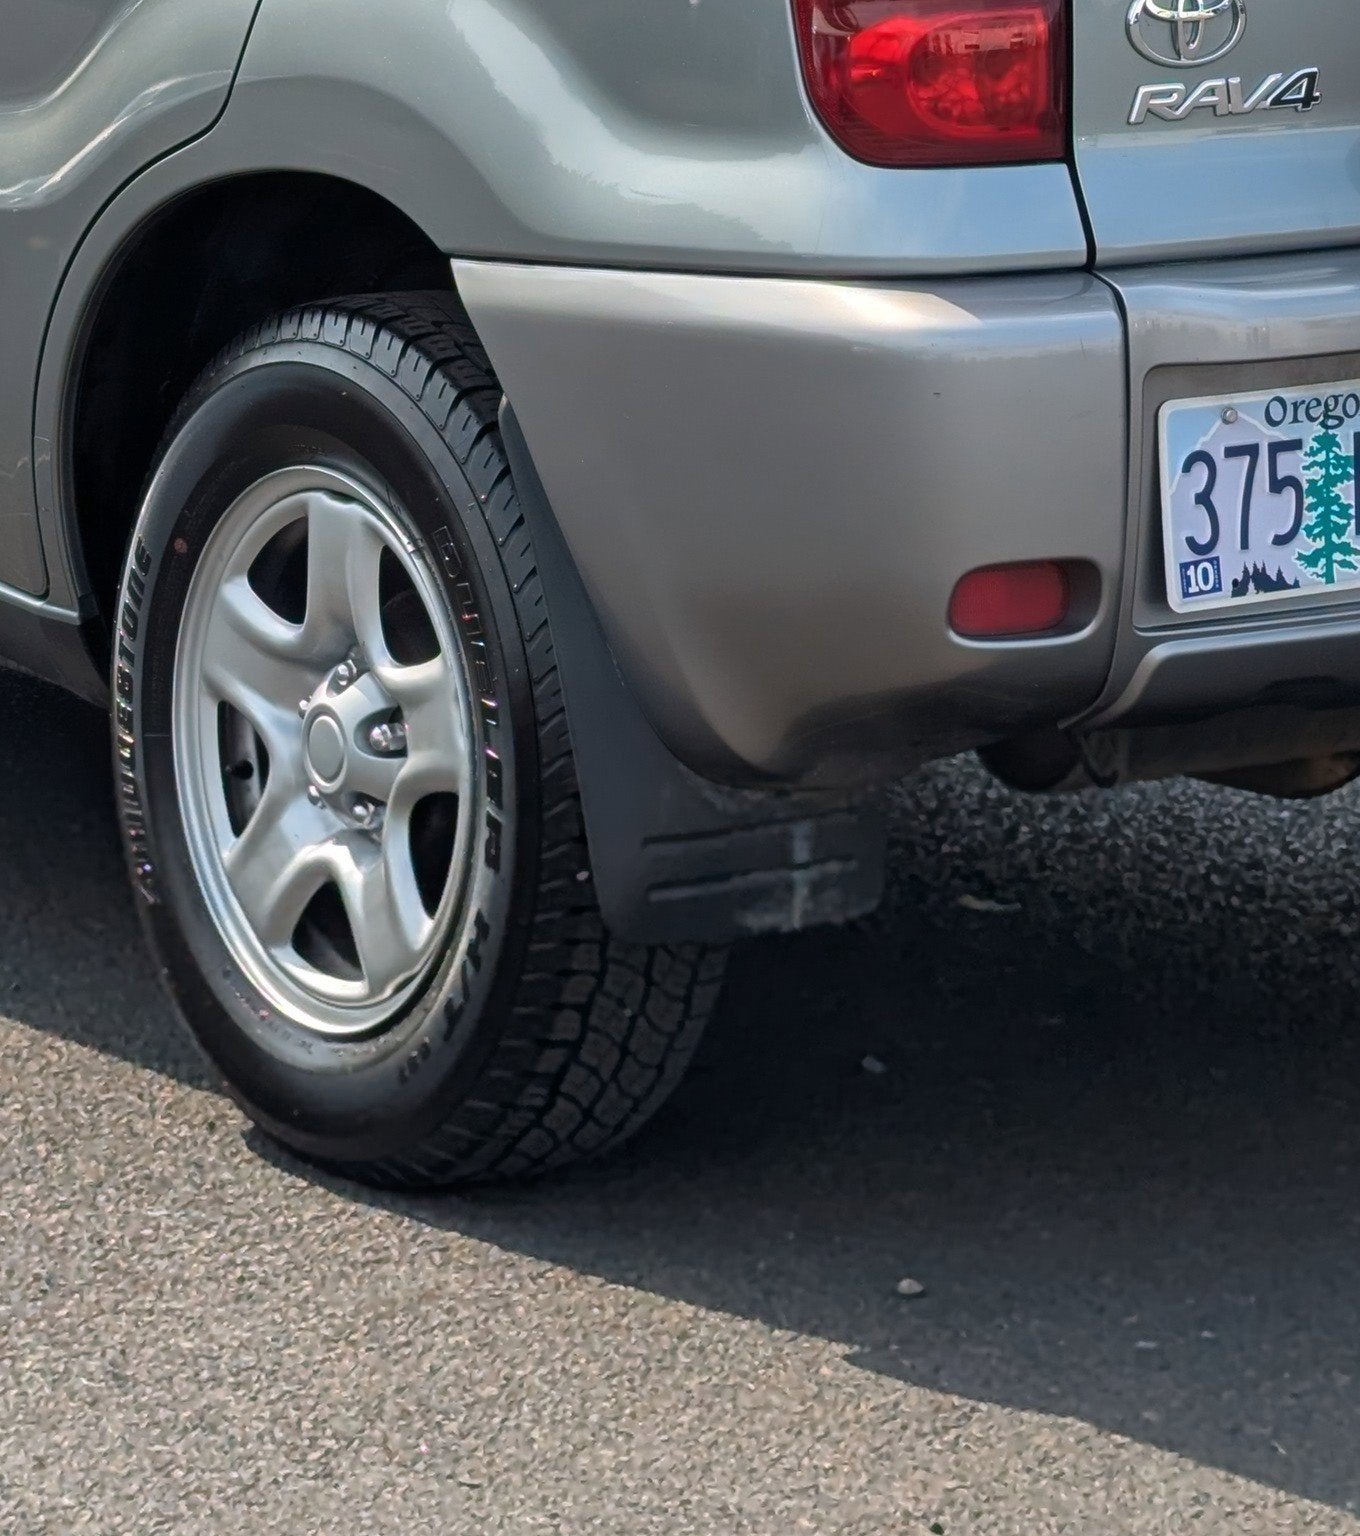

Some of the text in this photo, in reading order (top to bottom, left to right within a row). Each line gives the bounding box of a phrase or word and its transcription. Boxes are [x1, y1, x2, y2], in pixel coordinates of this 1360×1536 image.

[1126, 67, 1323, 125] RAV4
[1180, 438, 1304, 556] 375
[1186, 561, 1215, 594] 10
